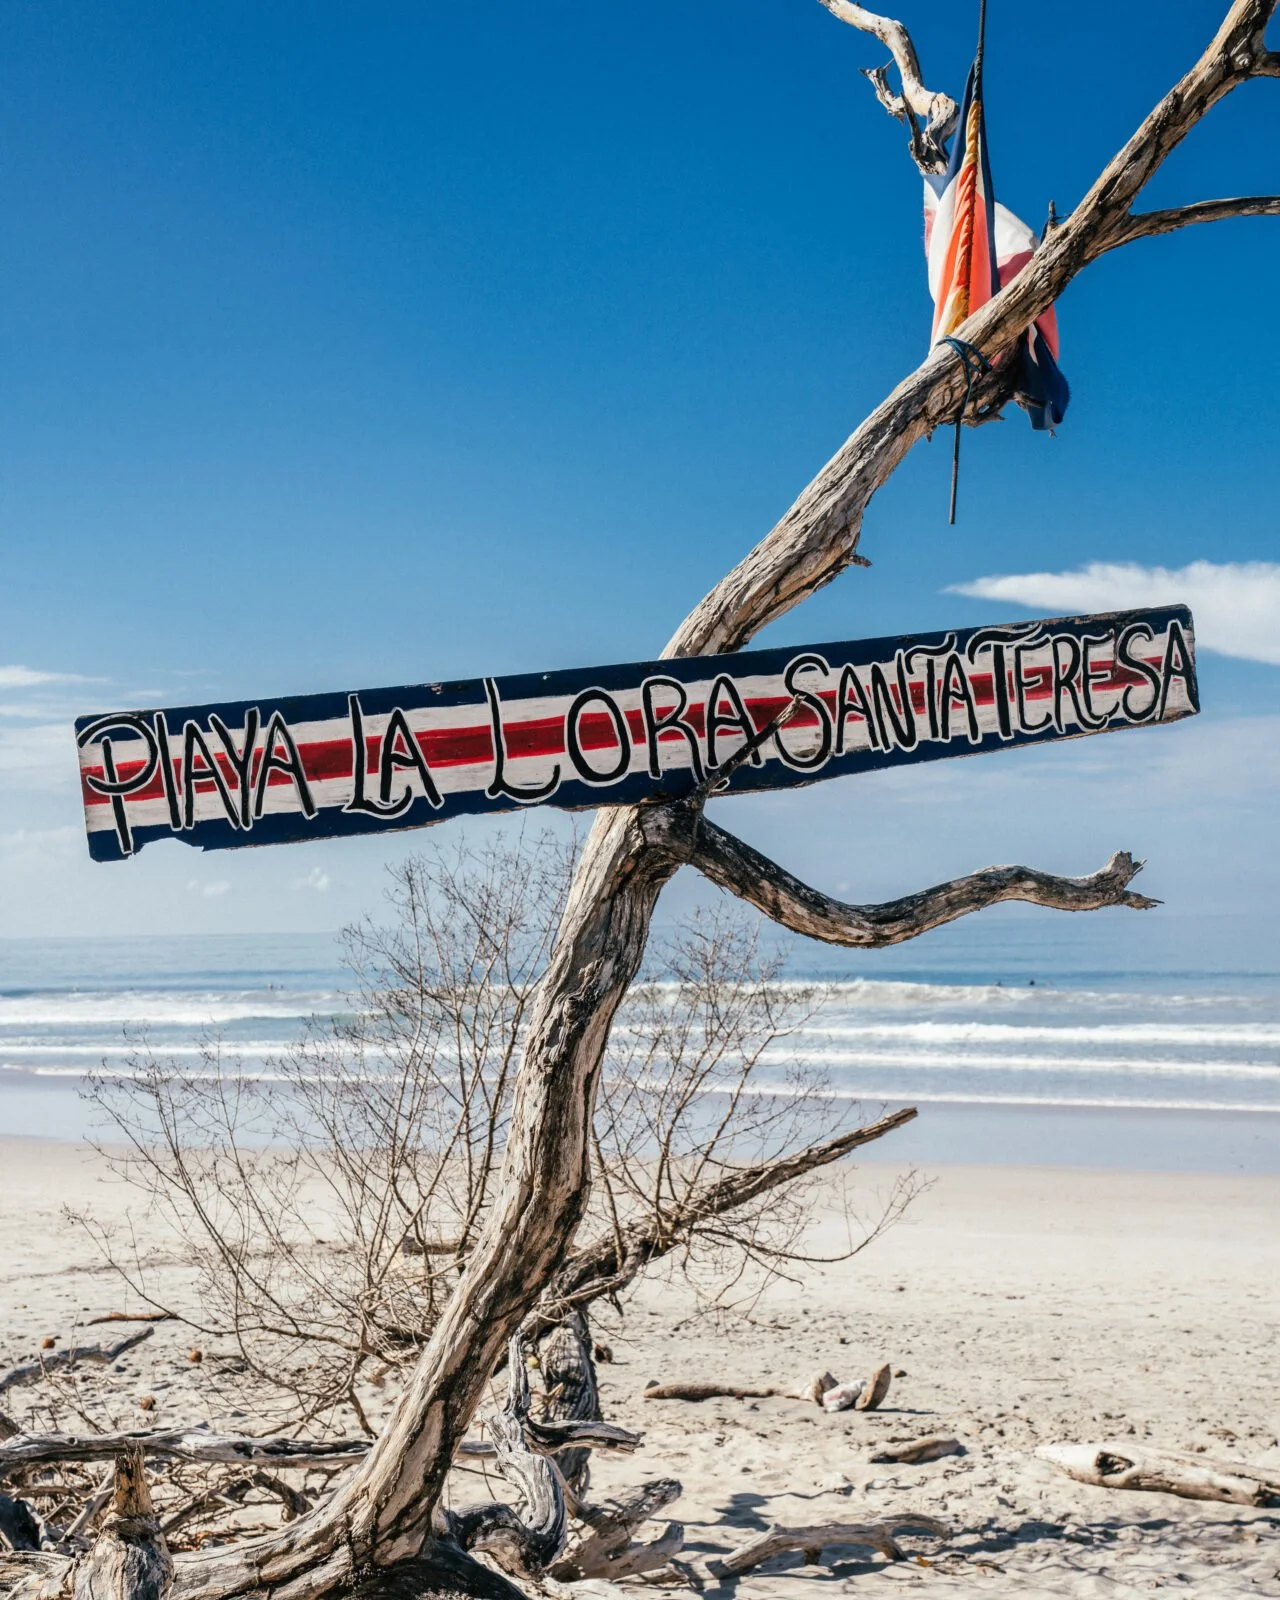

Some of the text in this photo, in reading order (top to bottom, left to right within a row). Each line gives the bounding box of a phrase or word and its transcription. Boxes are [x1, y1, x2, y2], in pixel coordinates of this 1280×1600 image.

[342, 693, 444, 819] LA
[483, 673, 766, 802] LORA
[772, 632, 982, 773] SANTA
[966, 618, 1200, 739] TERESA
